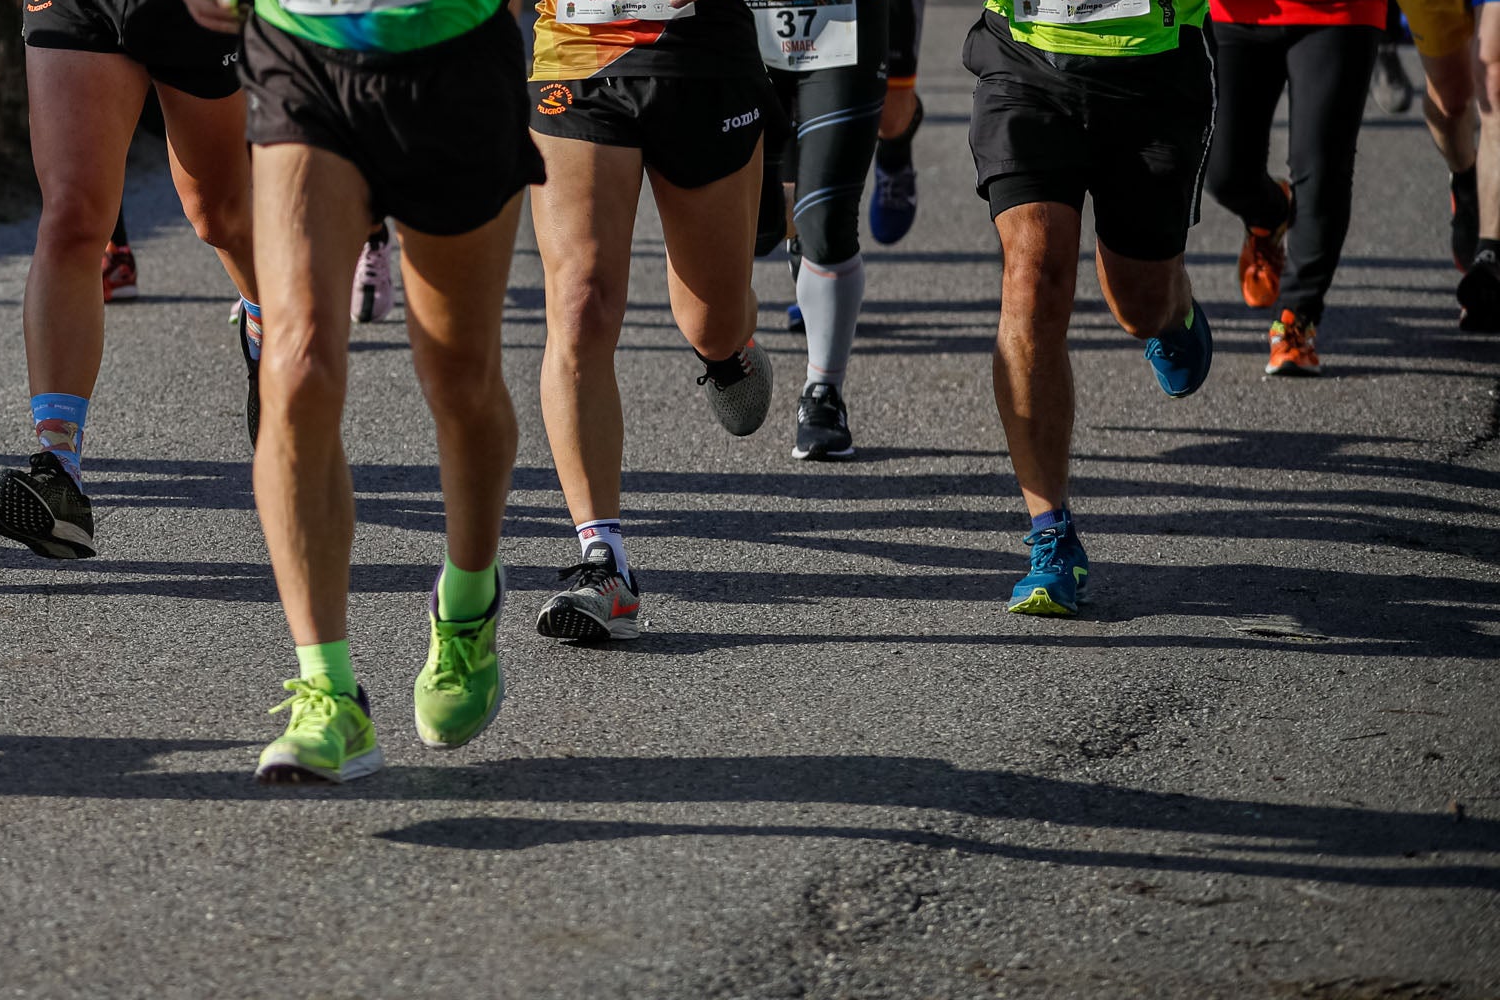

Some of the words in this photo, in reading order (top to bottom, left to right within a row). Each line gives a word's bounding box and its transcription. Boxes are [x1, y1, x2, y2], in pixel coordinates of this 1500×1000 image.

[621, 3, 647, 11] olimpo
[1076, 3, 1103, 11] olimpo
[776, 9, 818, 40] 37
[782, 40, 817, 53] ISMAEL
[537, 104, 567, 115] PELIGROS
